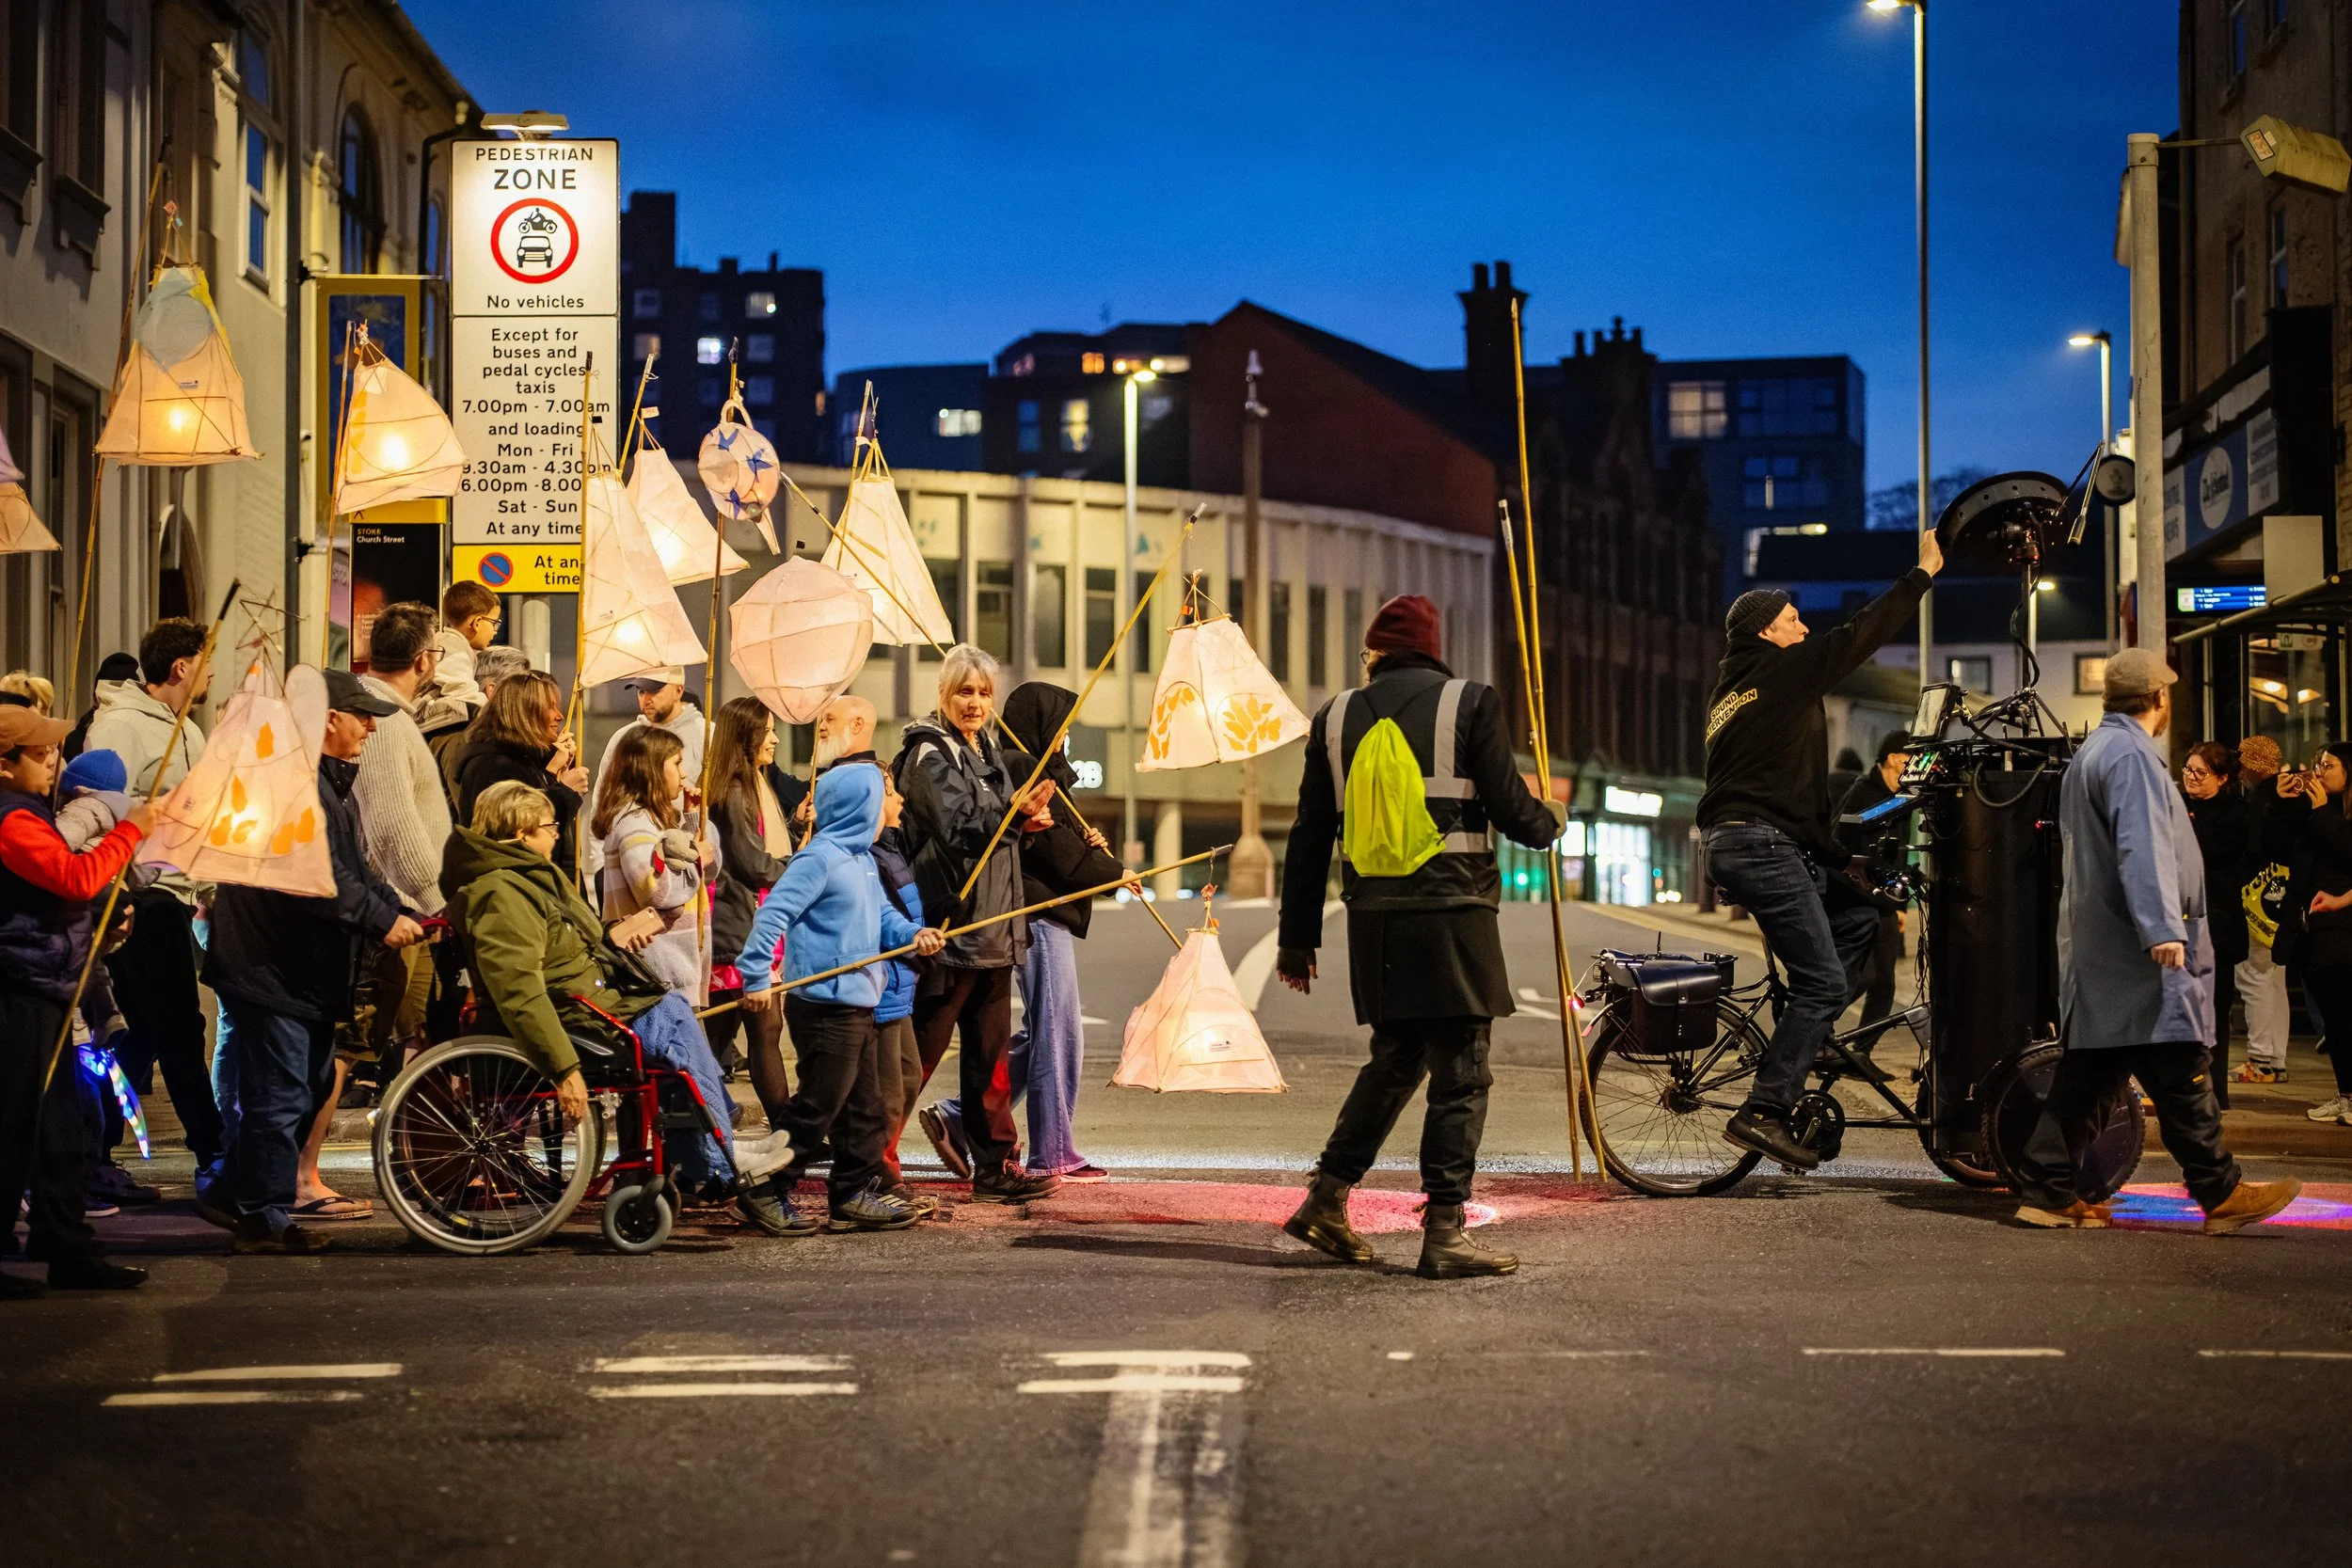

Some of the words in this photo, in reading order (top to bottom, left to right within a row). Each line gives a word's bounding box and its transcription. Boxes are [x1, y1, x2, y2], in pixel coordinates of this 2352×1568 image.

[475, 147, 594, 161] PEDESTRIAN
[494, 168, 577, 190] ZONE
[486, 294, 510, 309] No
[516, 294, 584, 309] vehicles
[491, 327, 548, 343] Except
[555, 327, 579, 341] for
[493, 345, 541, 359] buses
[547, 345, 577, 358] and
[483, 363, 529, 379] pedal
[534, 364, 587, 379] cycles
[516, 380, 556, 394] taxis
[462, 399, 528, 416] 7.00pm
[545, 399, 610, 413] 7.00am
[488, 421, 518, 436] and
[525, 421, 583, 438] loading
[498, 443, 532, 457] Mon
[552, 443, 573, 456] Fri
[462, 460, 526, 474] 9.30am
[461, 478, 528, 494] 6.00pm
[498, 499, 527, 514] Sat
[545, 499, 578, 514] Sun
[485, 521, 505, 535] At
[511, 524, 541, 537] any
[547, 521, 583, 535] time
[383, 535, 405, 544] Street
[534, 555, 553, 568] At
[559, 558, 580, 569] an
[544, 572, 580, 585] time
[1710, 692, 1738, 721] SOUND
